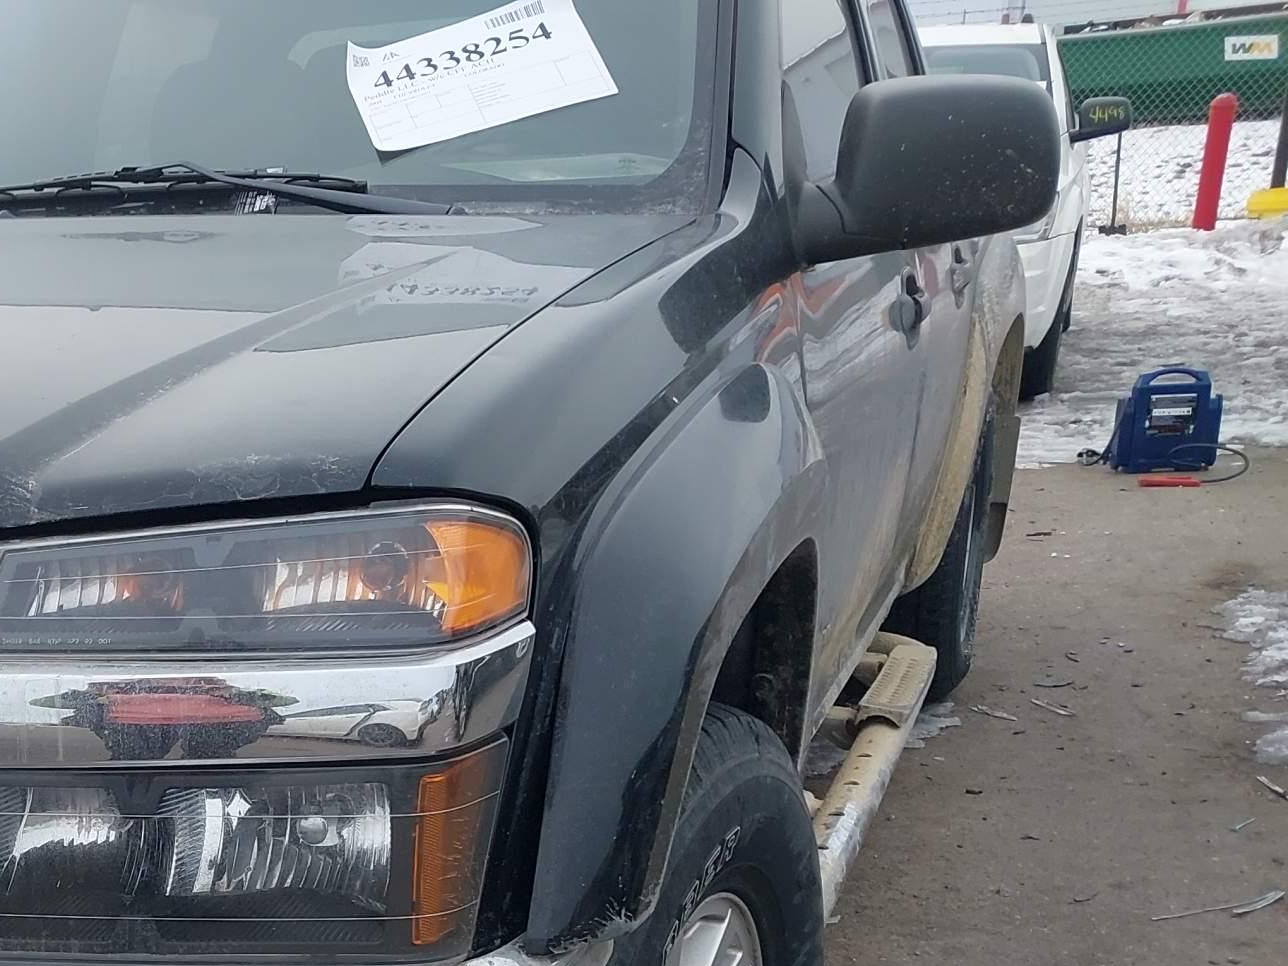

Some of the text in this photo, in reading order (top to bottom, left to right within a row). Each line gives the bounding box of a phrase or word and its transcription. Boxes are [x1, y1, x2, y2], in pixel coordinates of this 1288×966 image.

[374, 21, 553, 88] 44338254
[1231, 41, 1273, 55] WM
[1089, 105, 1125, 124] 4498
